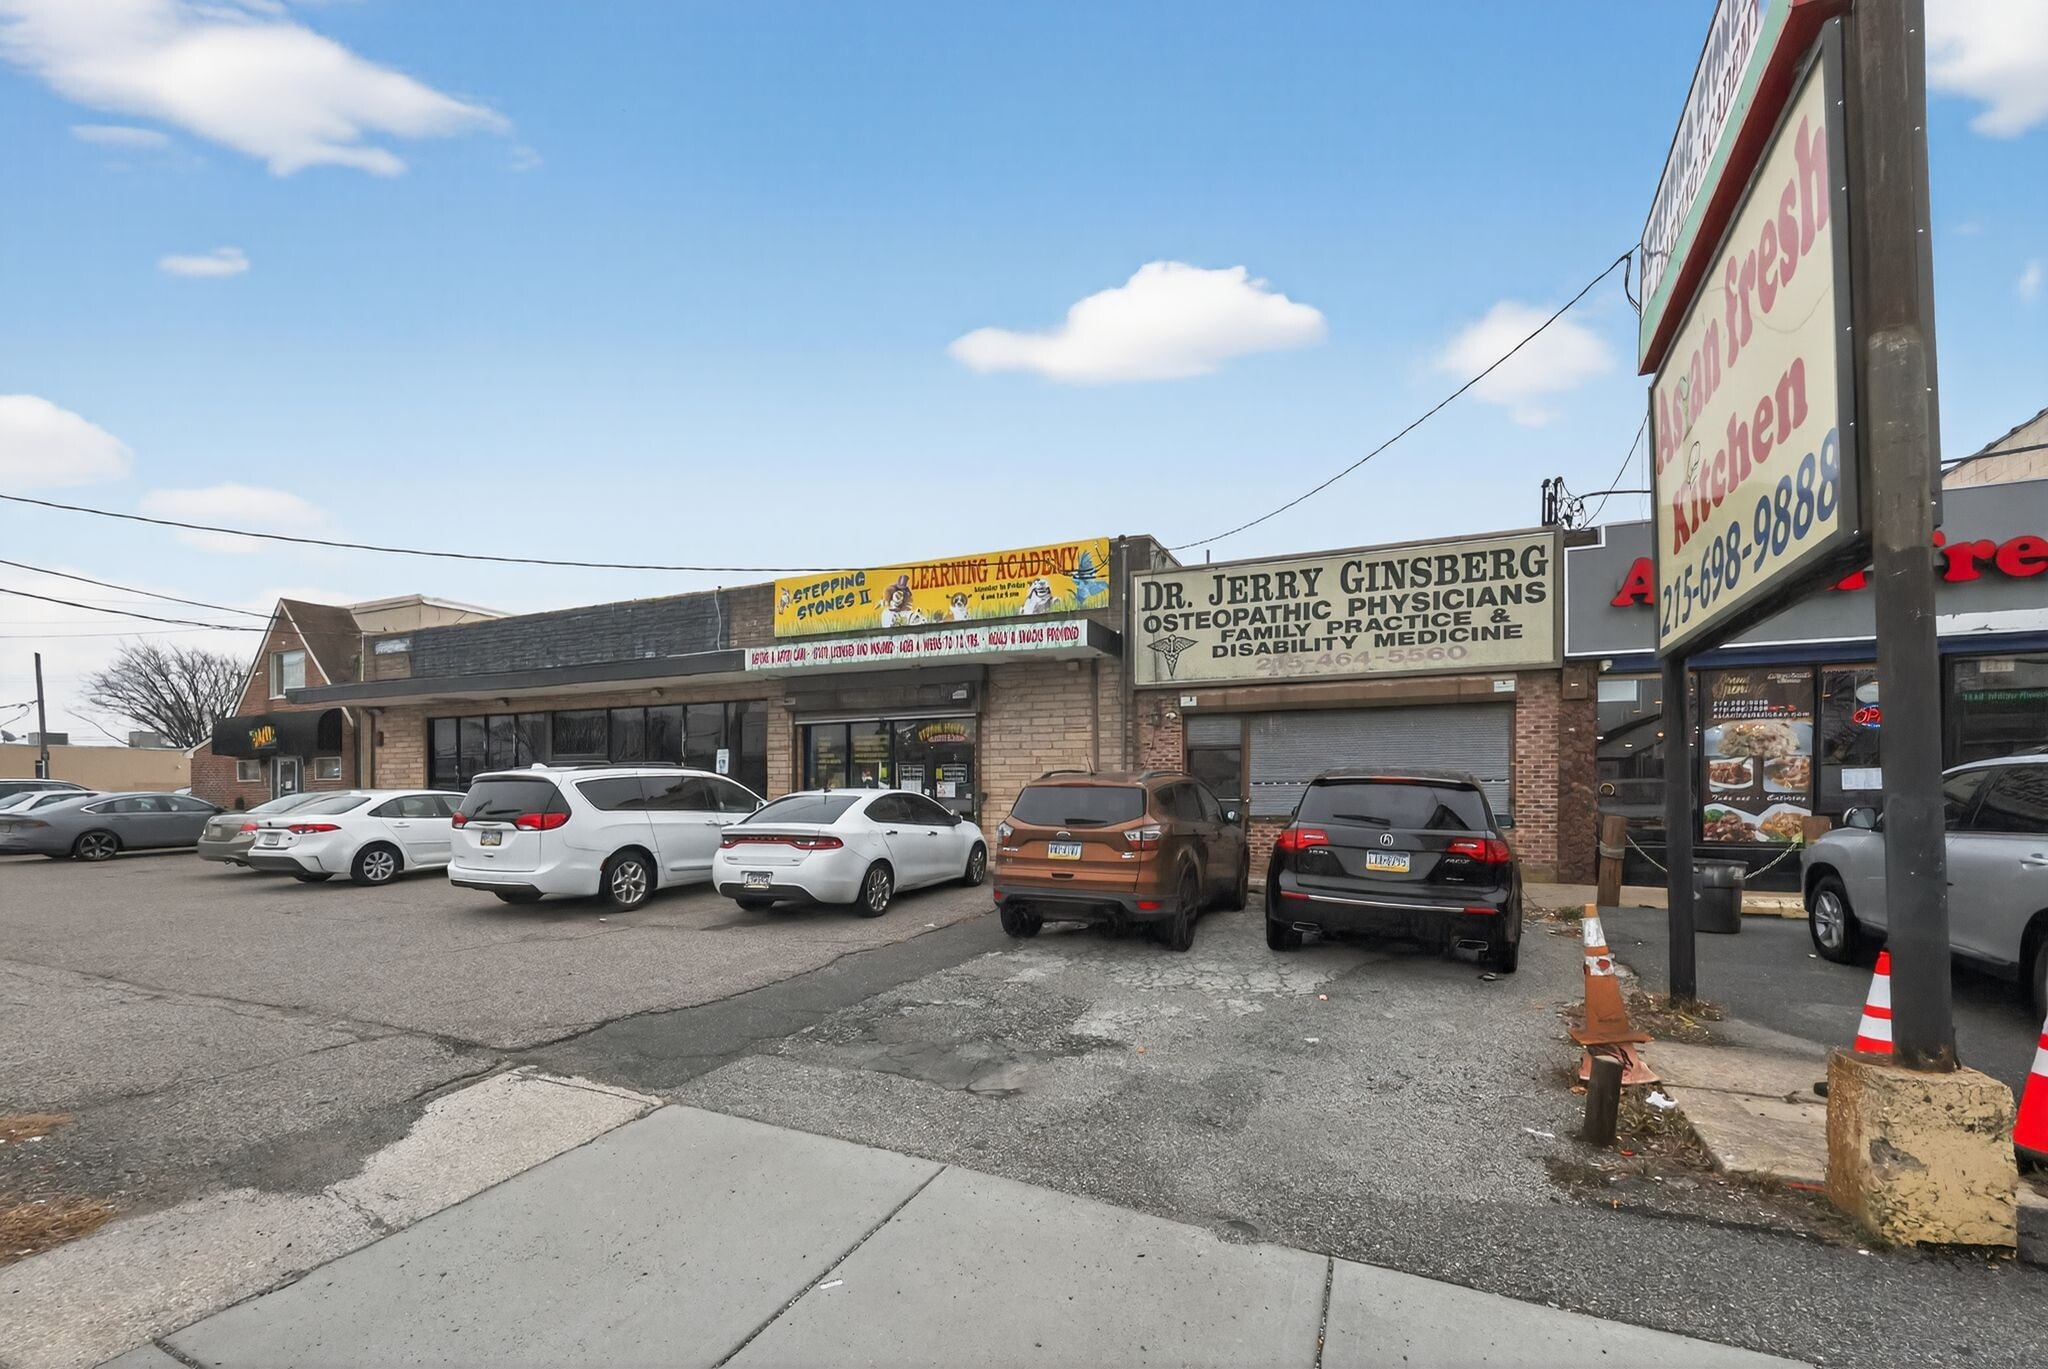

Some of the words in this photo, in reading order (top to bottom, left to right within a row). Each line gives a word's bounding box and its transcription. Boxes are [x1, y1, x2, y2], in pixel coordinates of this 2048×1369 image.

[1725, 114, 1829, 368] fresh
[1673, 356, 1808, 556] Kitchen
[1662, 428, 1838, 637] 215-698-9888
[793, 571, 866, 604] STEPPING
[911, 557, 988, 590] LEARNING
[995, 545, 1079, 581] ACADEMY
[1141, 581, 1193, 612] DR.
[1208, 566, 1323, 606] JERRY
[1340, 544, 1549, 594] GINSBERG
[797, 592, 855, 620] STONES
[850, 588, 872, 605] II
[1143, 600, 1332, 634] OSTEOPATHIC
[1348, 581, 1547, 617] PHYSICIANS
[1221, 623, 1312, 643] FAMILY
[1326, 611, 1473, 635] PRACTICE
[1490, 608, 1512, 623] &
[1211, 635, 1359, 659] DISABILITY
[1374, 624, 1523, 649] MEDICINE
